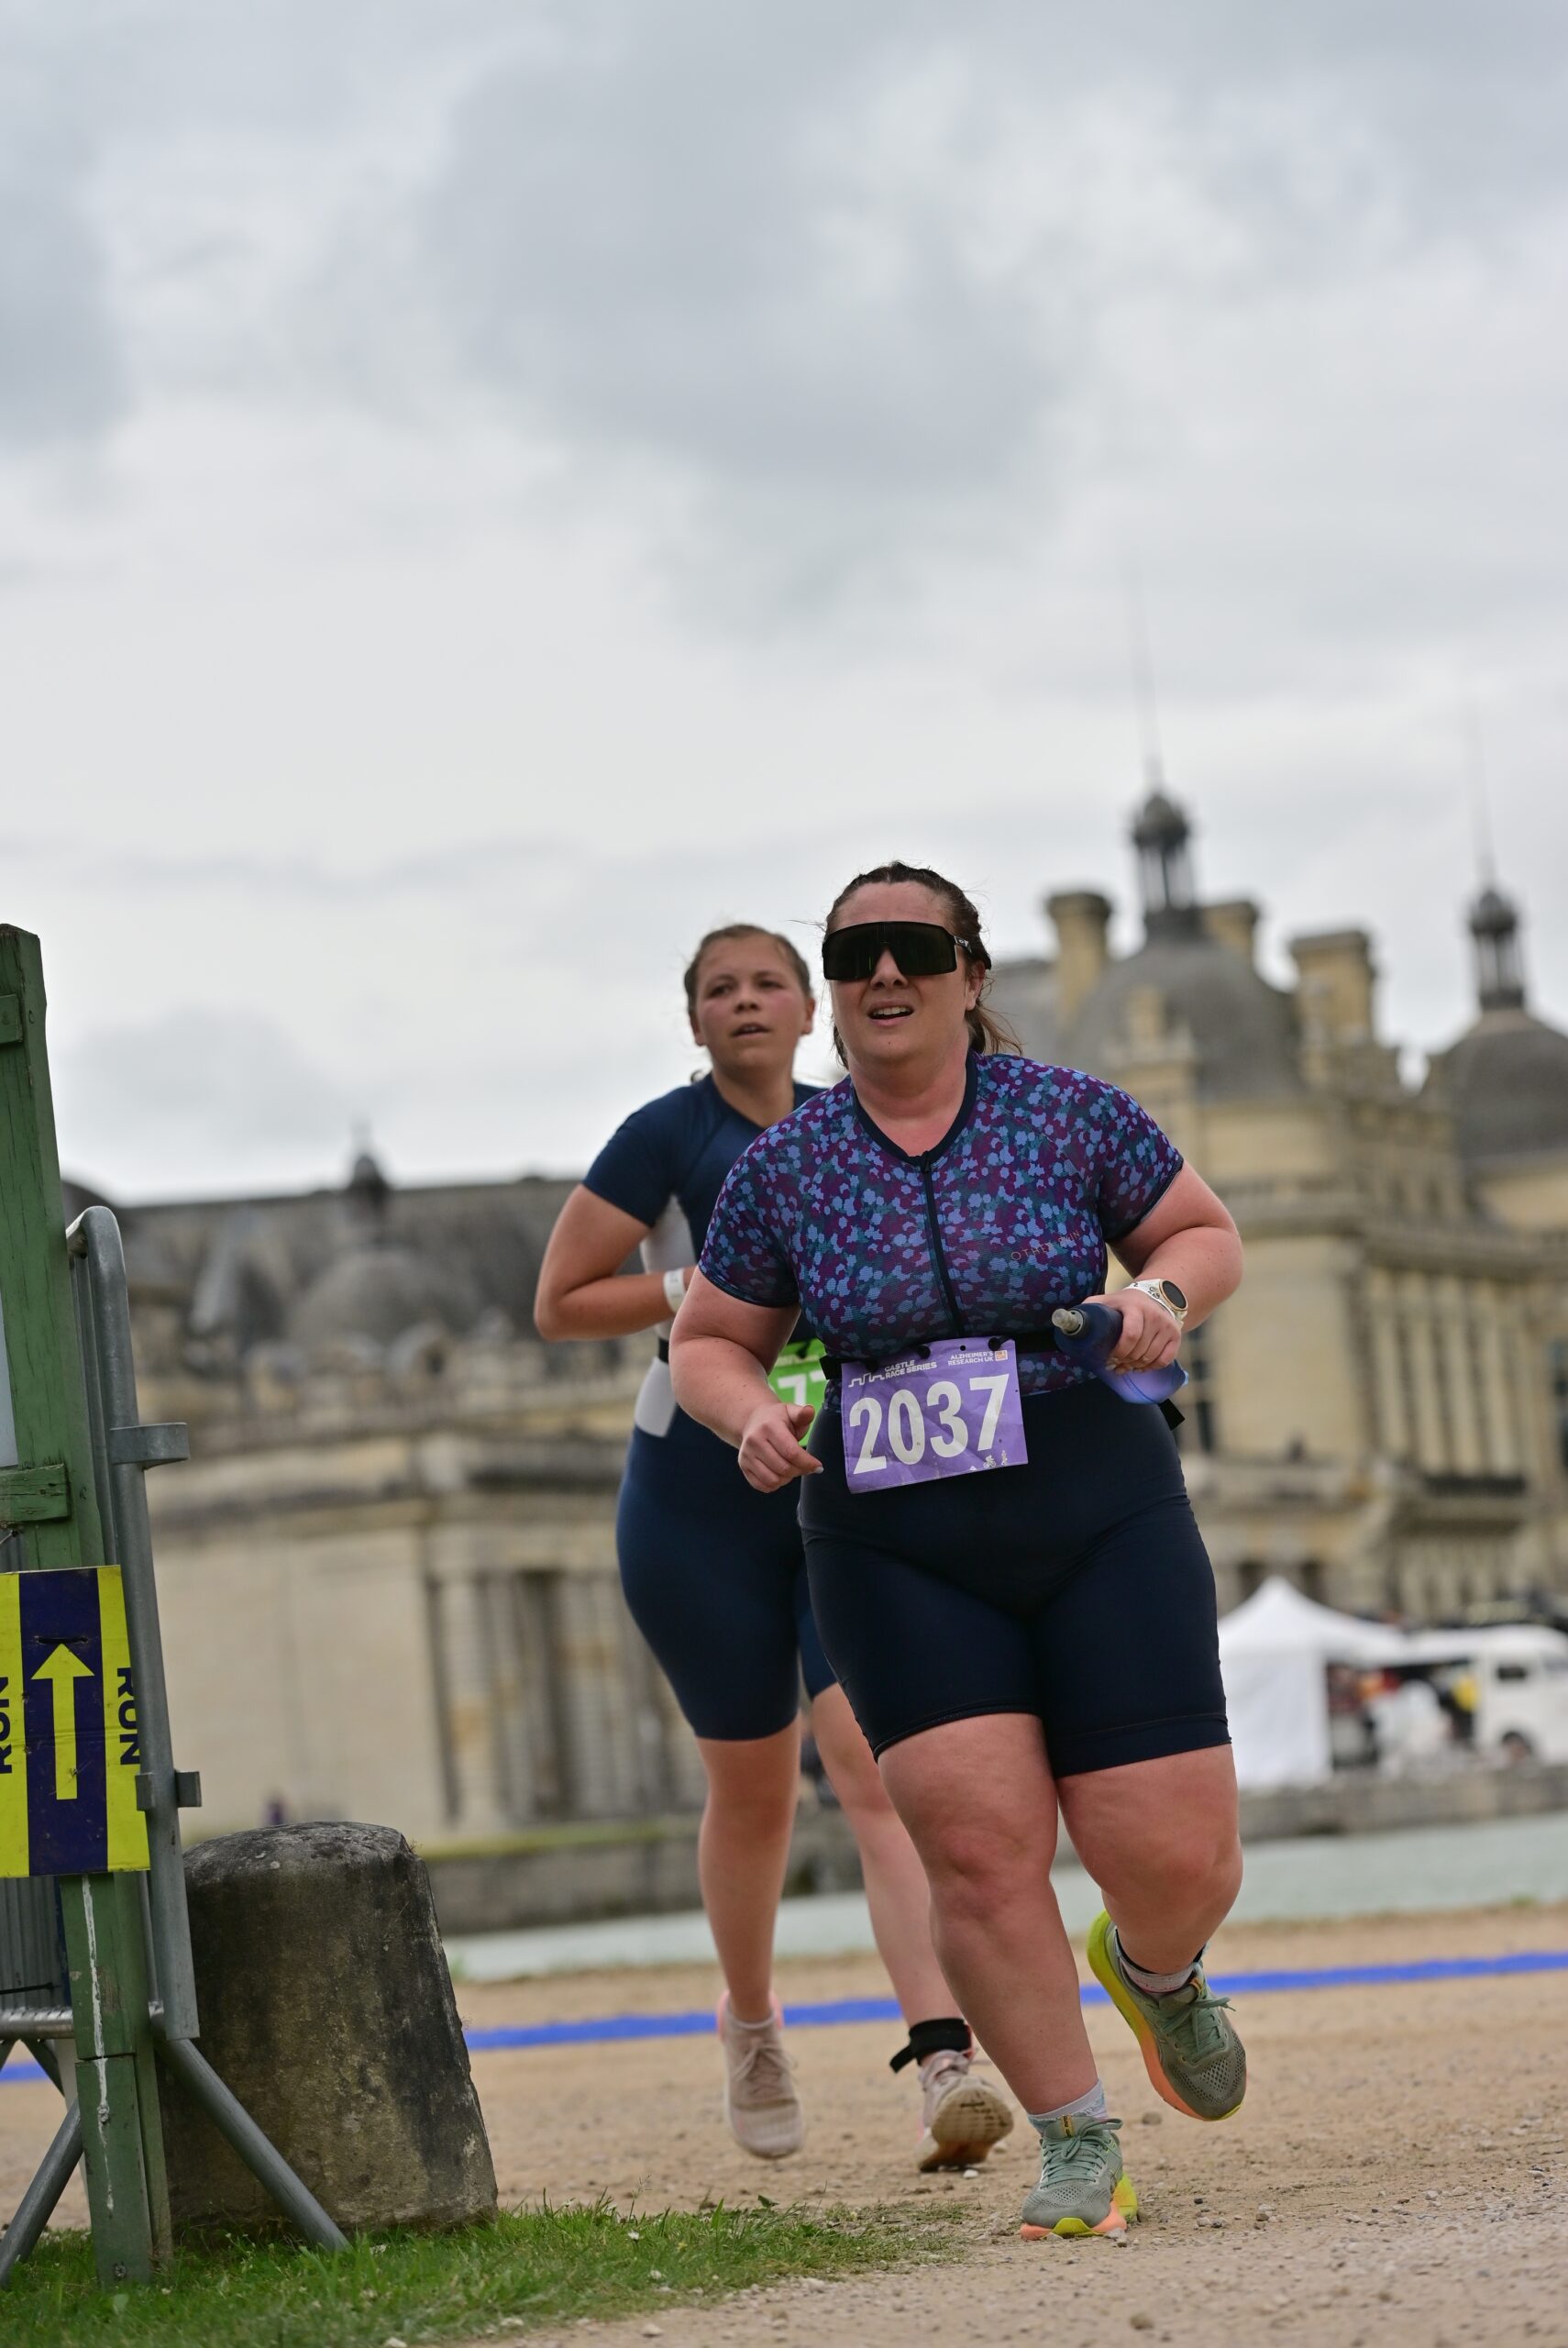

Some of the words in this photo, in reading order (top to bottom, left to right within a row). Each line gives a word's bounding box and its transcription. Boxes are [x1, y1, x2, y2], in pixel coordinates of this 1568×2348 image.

[947, 1357, 984, 1366] RESEARCH
[950, 1351, 994, 1360] ALZHEIMER'S
[885, 1359, 915, 1372] CASTLE
[886, 1368, 905, 1379] RACE
[906, 1361, 937, 1374] SERIES
[849, 1374, 1010, 1475] 2037
